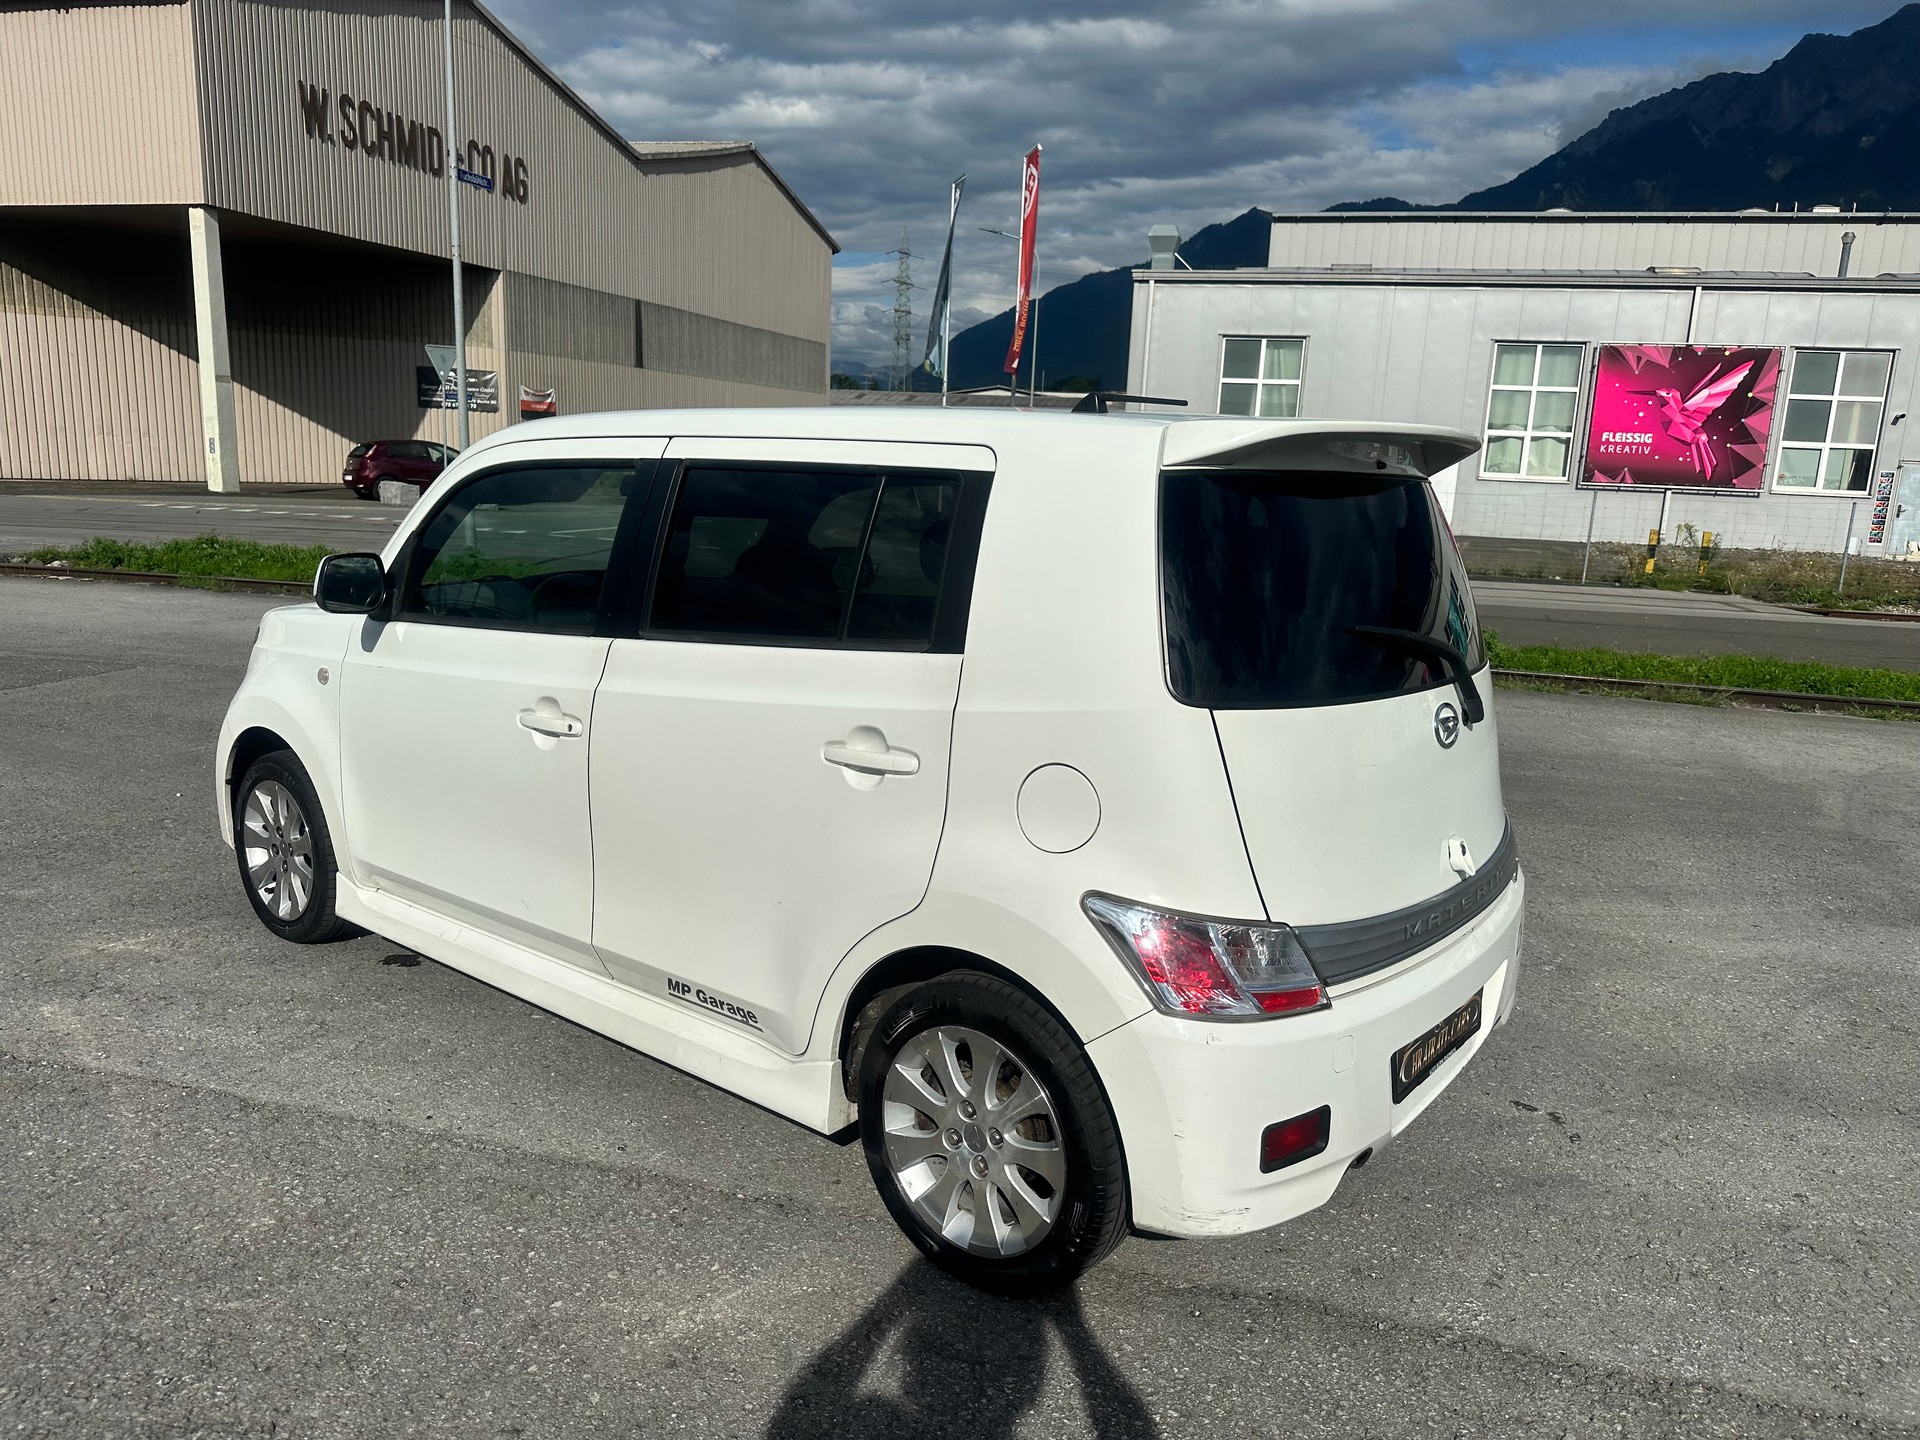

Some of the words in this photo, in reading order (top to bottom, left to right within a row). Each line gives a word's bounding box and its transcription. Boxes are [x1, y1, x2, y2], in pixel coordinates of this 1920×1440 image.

[339, 94, 444, 179] SCHMID
[502, 153, 528, 205] AG
[1600, 445, 1651, 455] KREATIV
[1602, 432, 1653, 443] FLEISSIG
[667, 977, 692, 996] MP
[695, 988, 759, 1025] Garage
